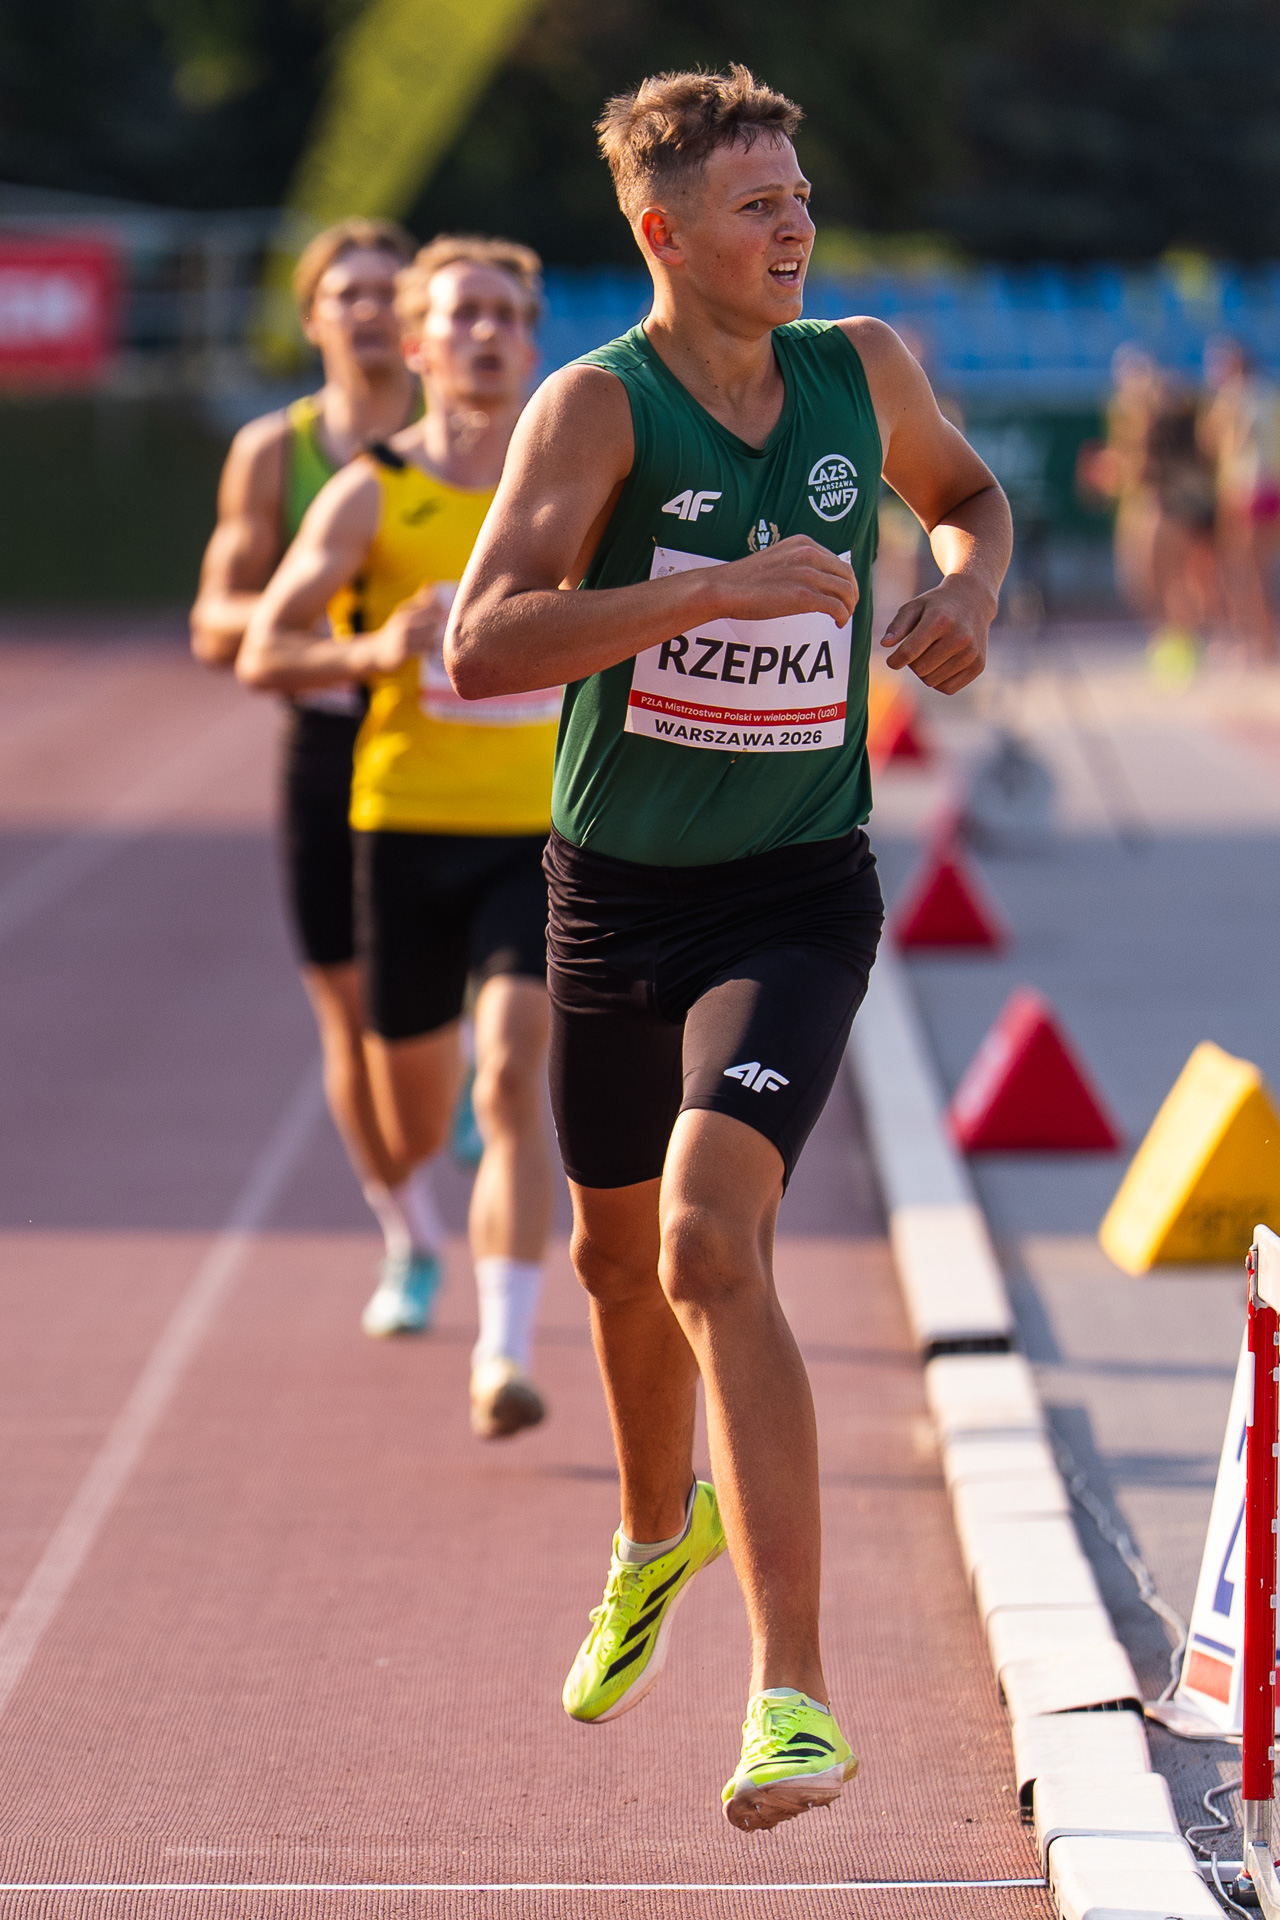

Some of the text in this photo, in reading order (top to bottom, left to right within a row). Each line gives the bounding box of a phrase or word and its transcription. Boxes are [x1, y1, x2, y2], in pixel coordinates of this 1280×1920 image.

[815, 480, 854, 492] WARSZAWA
[819, 463, 848, 483] AZS
[661, 489, 722, 522] 4F
[820, 488, 855, 509] AWF
[657, 634, 835, 685] RZEPKA
[641, 695, 838, 723] PZLA Mistrzostwa Polski w wielobojach (U20)
[654, 718, 823, 746] WARSZAWA 2026
[723, 1061, 790, 1093] 4F
